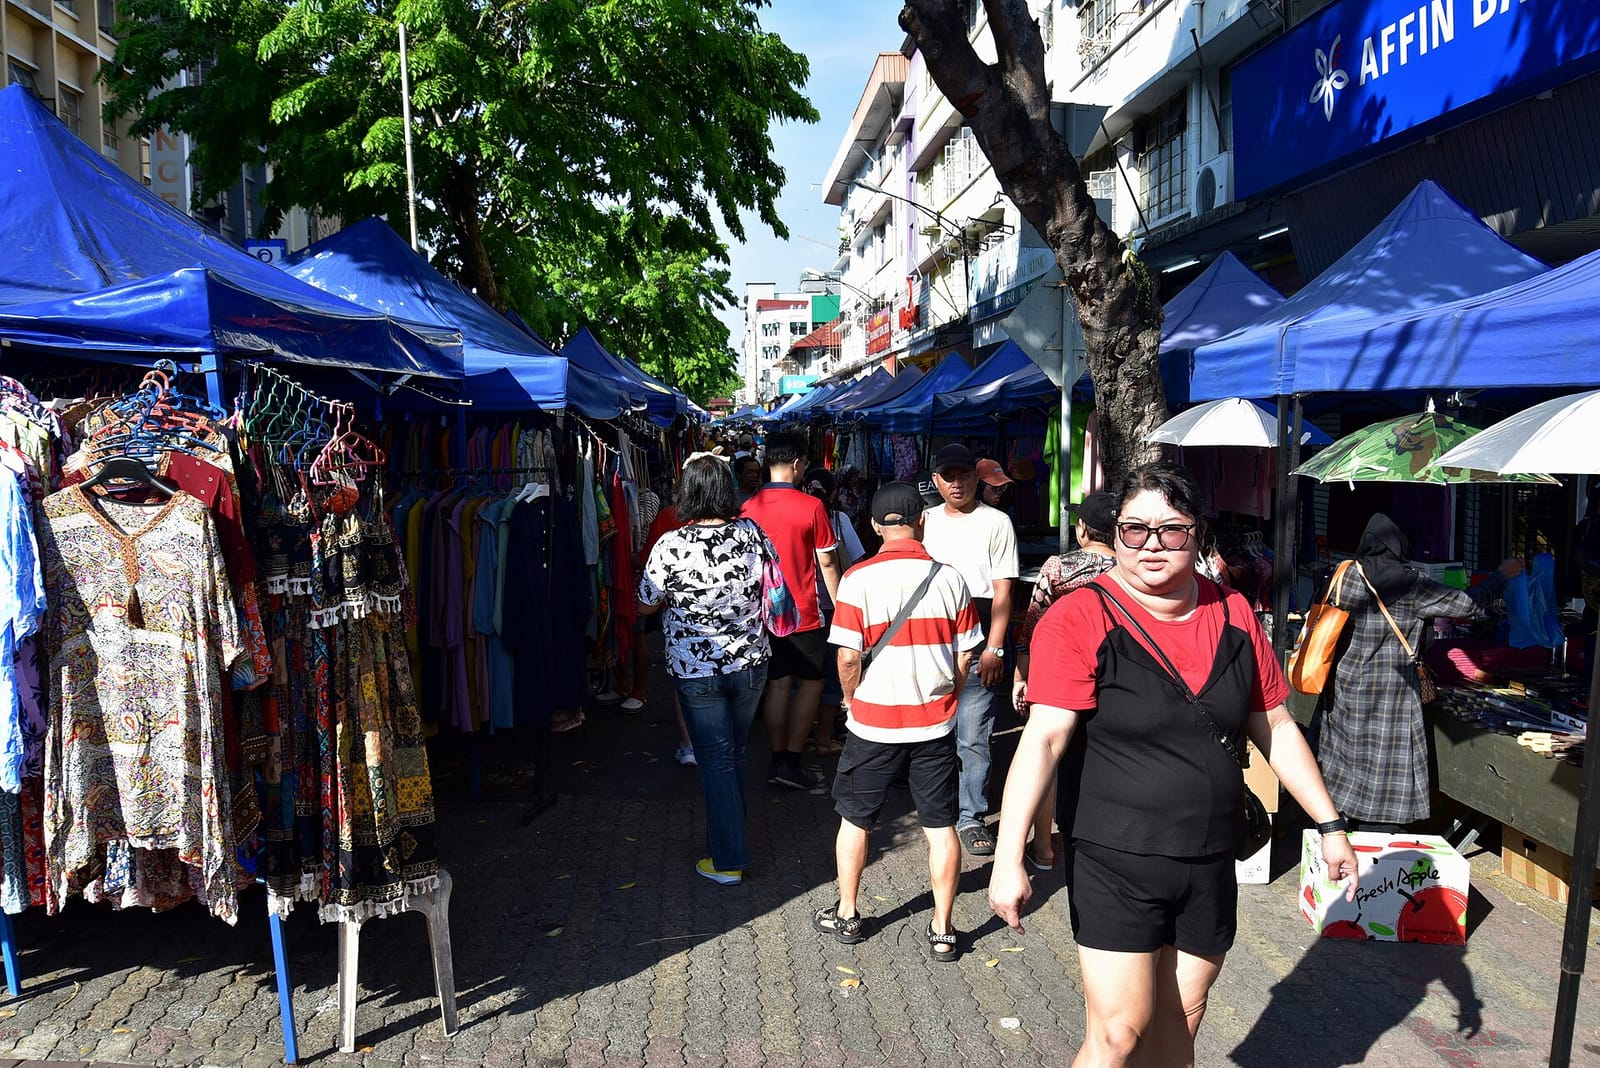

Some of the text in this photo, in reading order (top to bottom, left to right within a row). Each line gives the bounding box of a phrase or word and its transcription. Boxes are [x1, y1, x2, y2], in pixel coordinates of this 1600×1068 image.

[1359, 0, 1527, 87] AFFIN B
[1397, 865, 1440, 891] Apple
